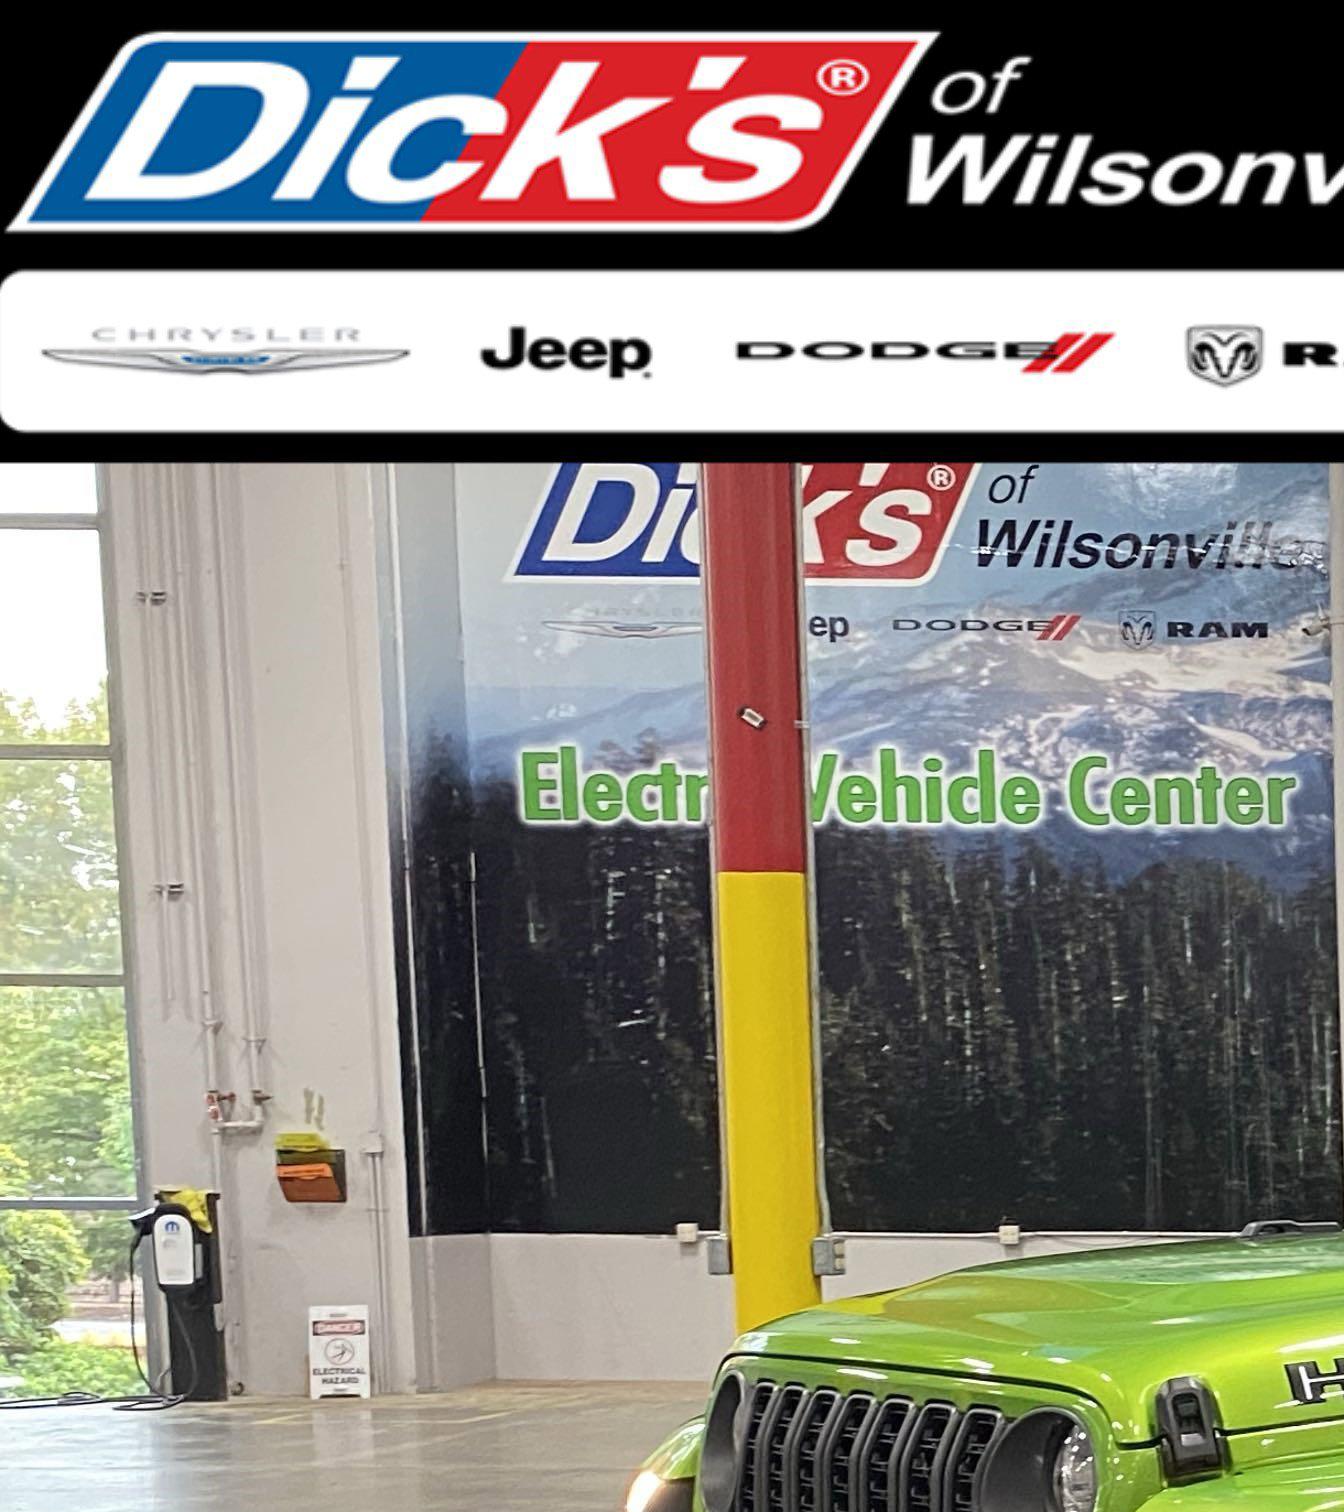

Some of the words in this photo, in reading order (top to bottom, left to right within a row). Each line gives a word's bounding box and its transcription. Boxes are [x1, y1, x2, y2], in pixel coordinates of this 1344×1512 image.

[988, 464, 1039, 504] of
[808, 615, 850, 642] ep
[892, 618, 1053, 632] DODGE
[1167, 621, 1269, 638] RAM
[521, 746, 709, 822] Electr
[812, 748, 1041, 825] Vehicle
[1067, 755, 1296, 826] Center
